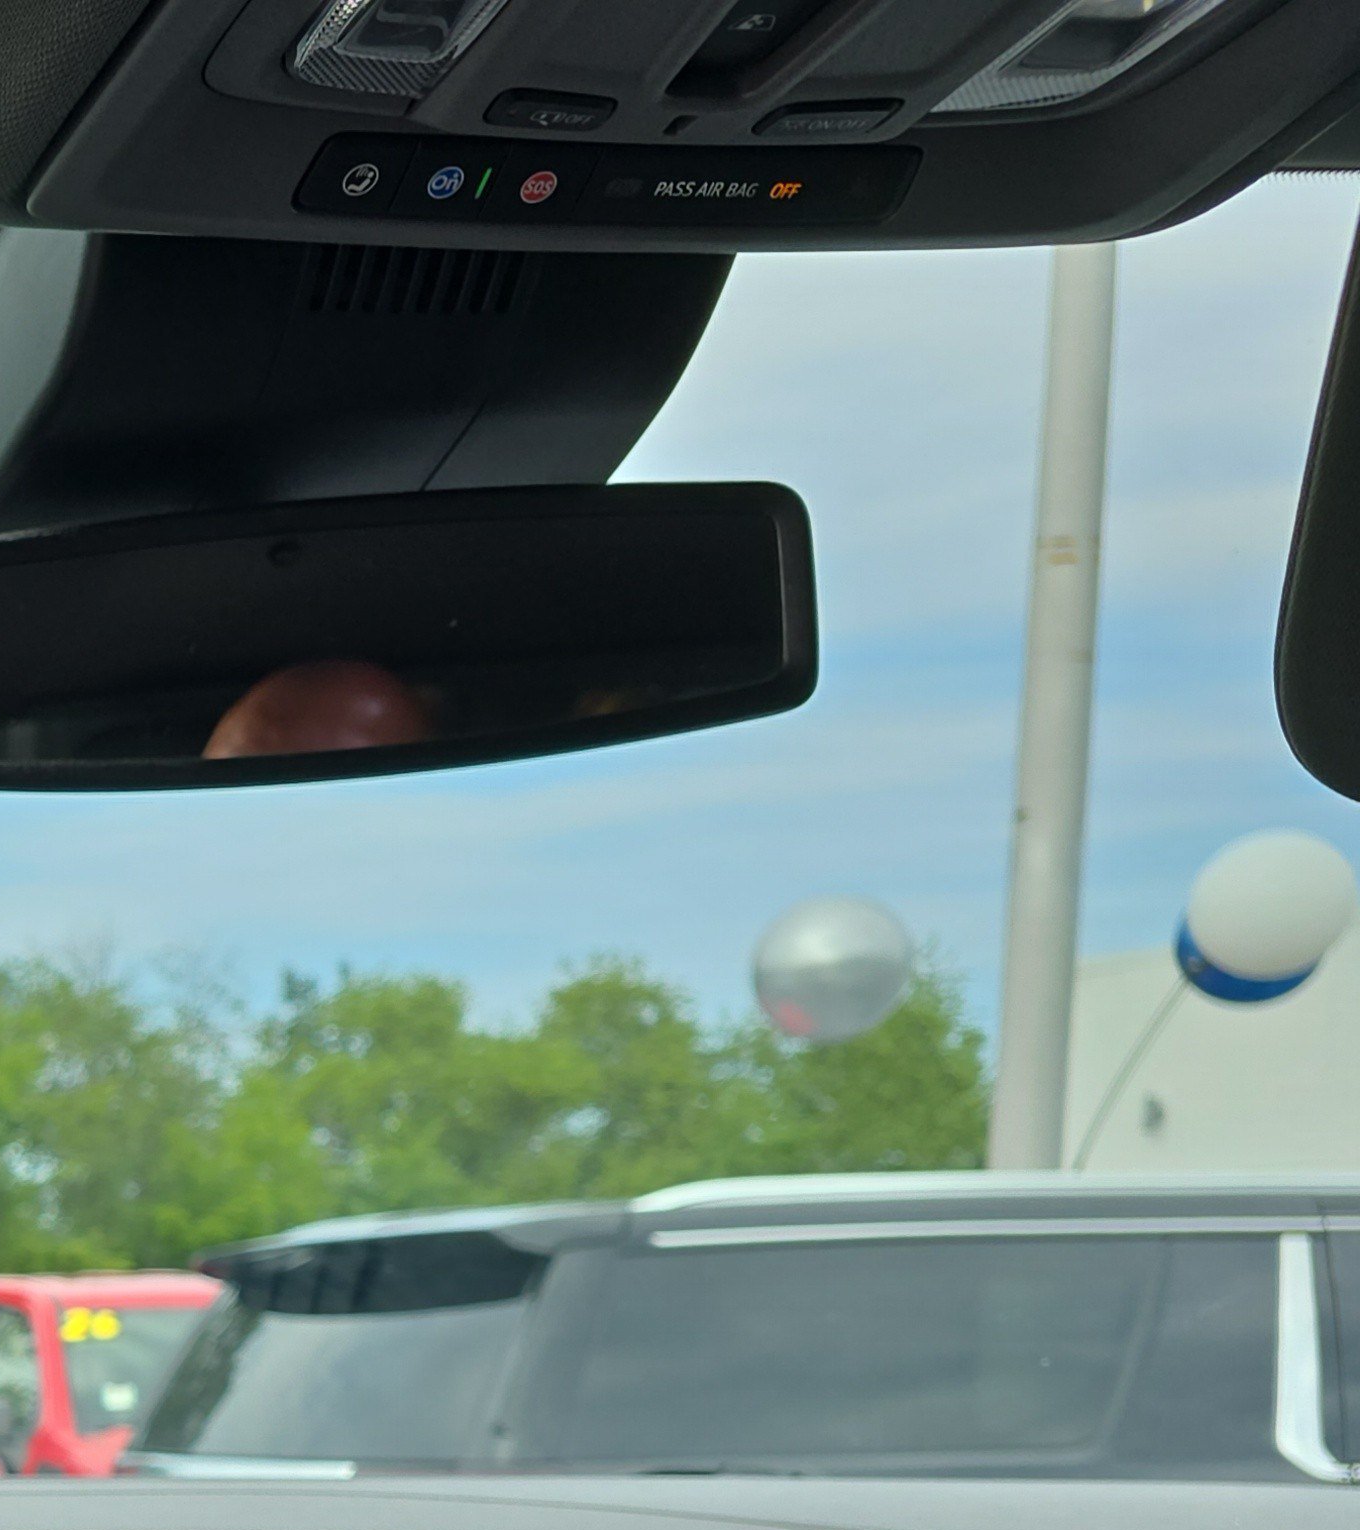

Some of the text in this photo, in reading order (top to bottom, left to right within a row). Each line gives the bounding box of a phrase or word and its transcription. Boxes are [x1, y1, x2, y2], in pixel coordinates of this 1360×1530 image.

[524, 179, 553, 196] SOS
[654, 180, 801, 199] PASS AIR BAG OFF
[58, 1306, 122, 1342] 26
